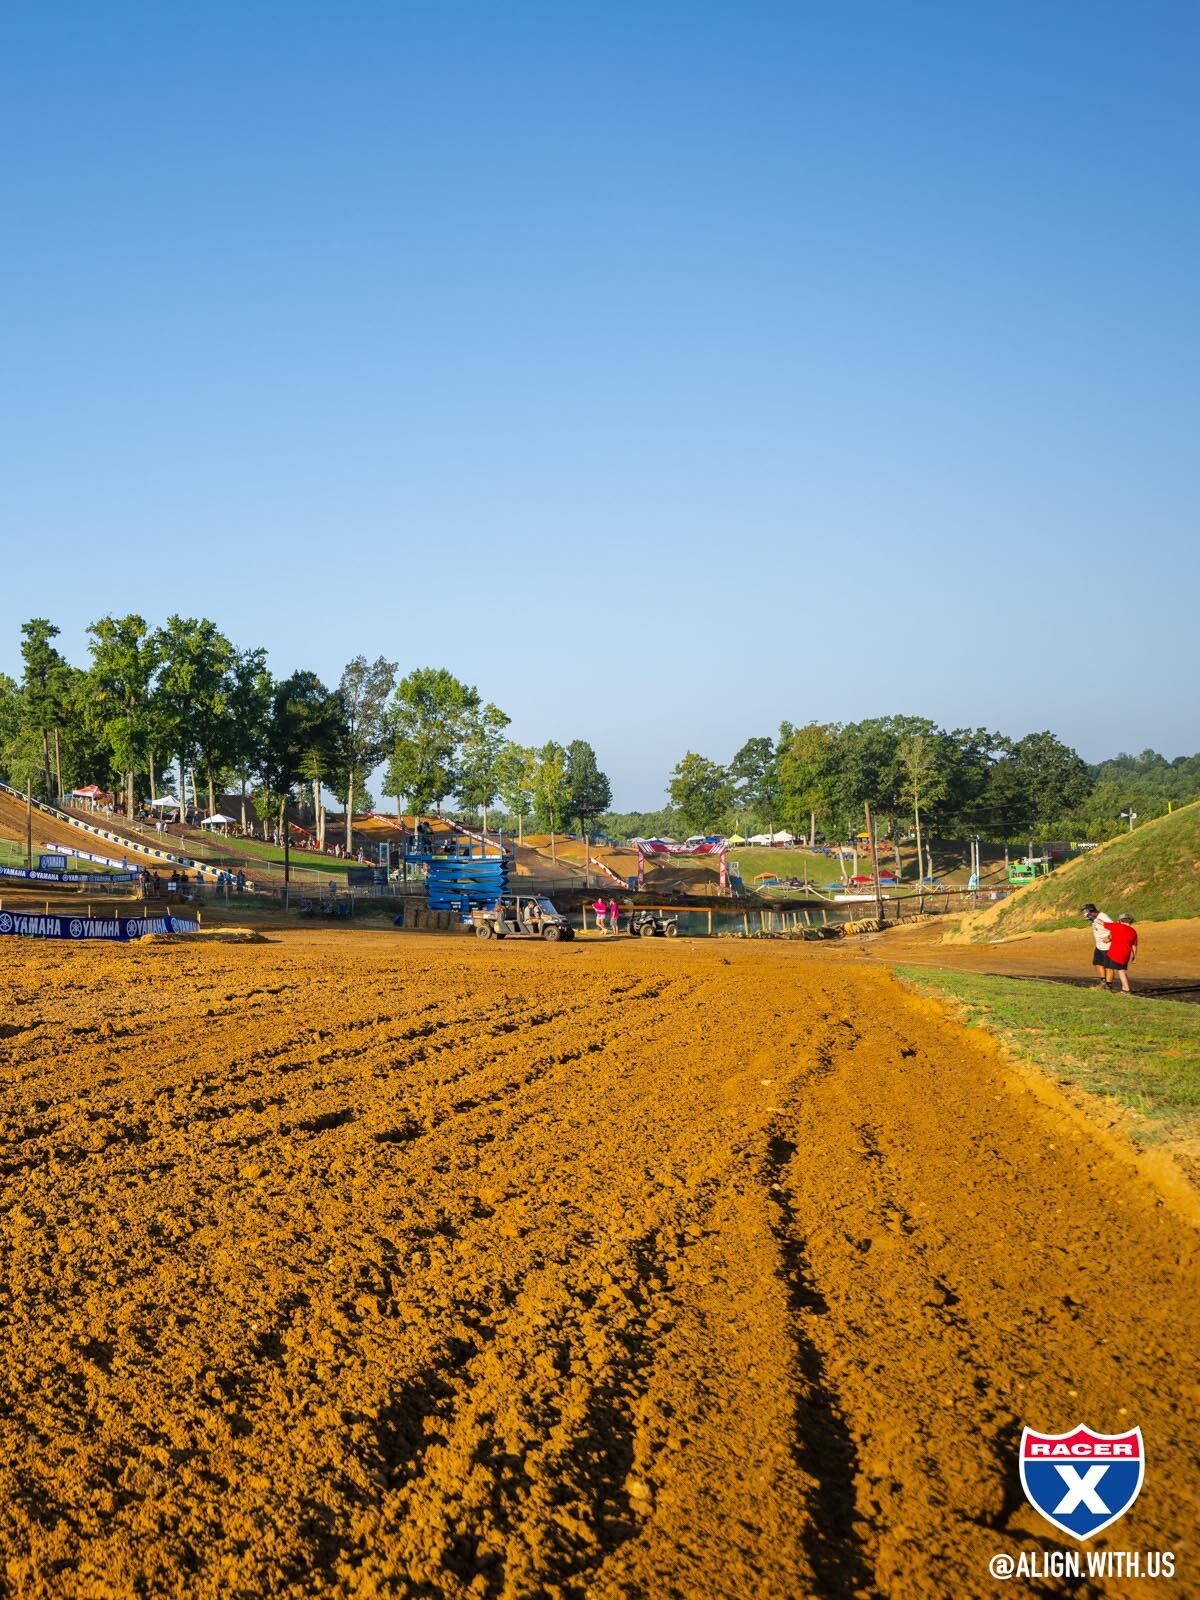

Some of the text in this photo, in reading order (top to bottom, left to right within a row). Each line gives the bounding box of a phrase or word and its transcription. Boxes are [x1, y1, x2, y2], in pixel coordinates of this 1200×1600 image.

[3, 868, 26, 878] YAMAHA
[36, 872, 59, 881] YAMAHA
[13, 915, 61, 935] YAMAHA
[82, 920, 120, 937] YAMAHA
[137, 918, 166, 936] YAMAHA
